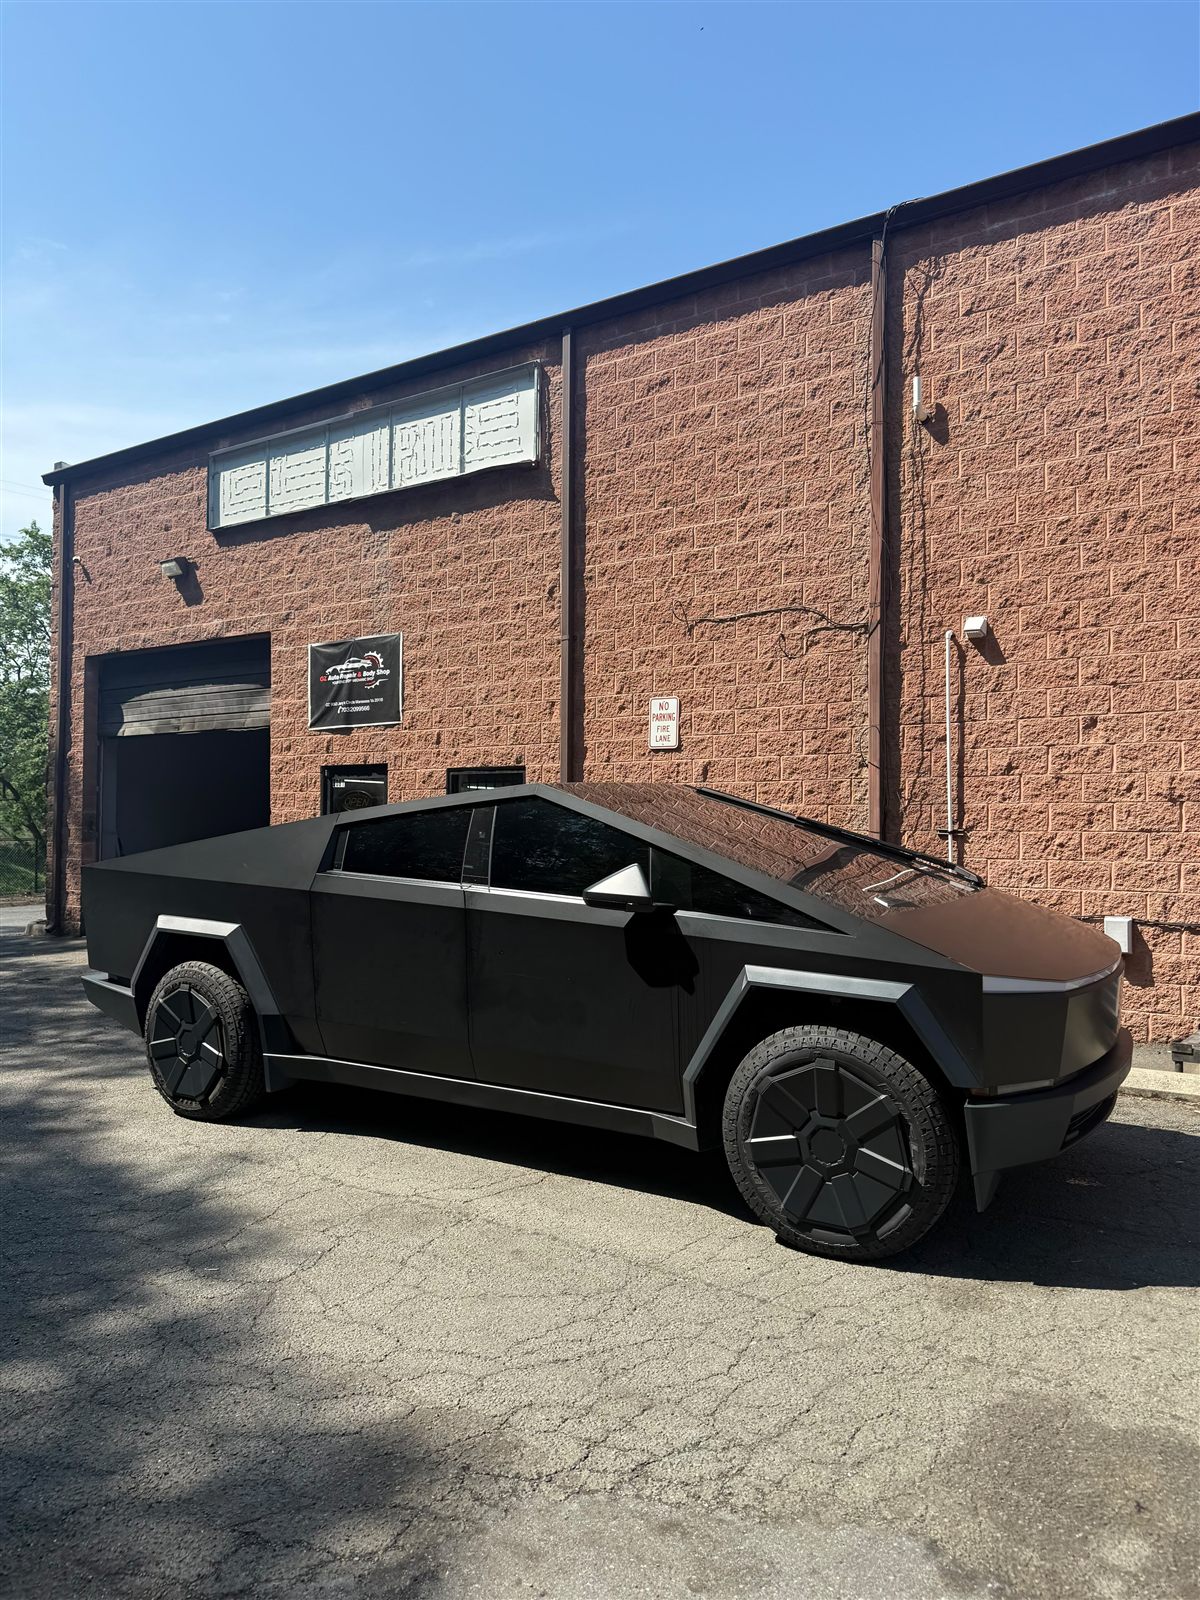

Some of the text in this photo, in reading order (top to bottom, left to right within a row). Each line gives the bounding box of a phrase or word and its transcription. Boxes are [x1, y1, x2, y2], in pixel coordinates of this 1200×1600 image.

[340, 672, 357, 680] Repair
[658, 701, 670, 711] NO
[652, 712, 676, 722] PARKING
[656, 725, 670, 733] FIRE
[655, 735, 671, 743] LANE
[344, 797, 369, 807] OPEN
